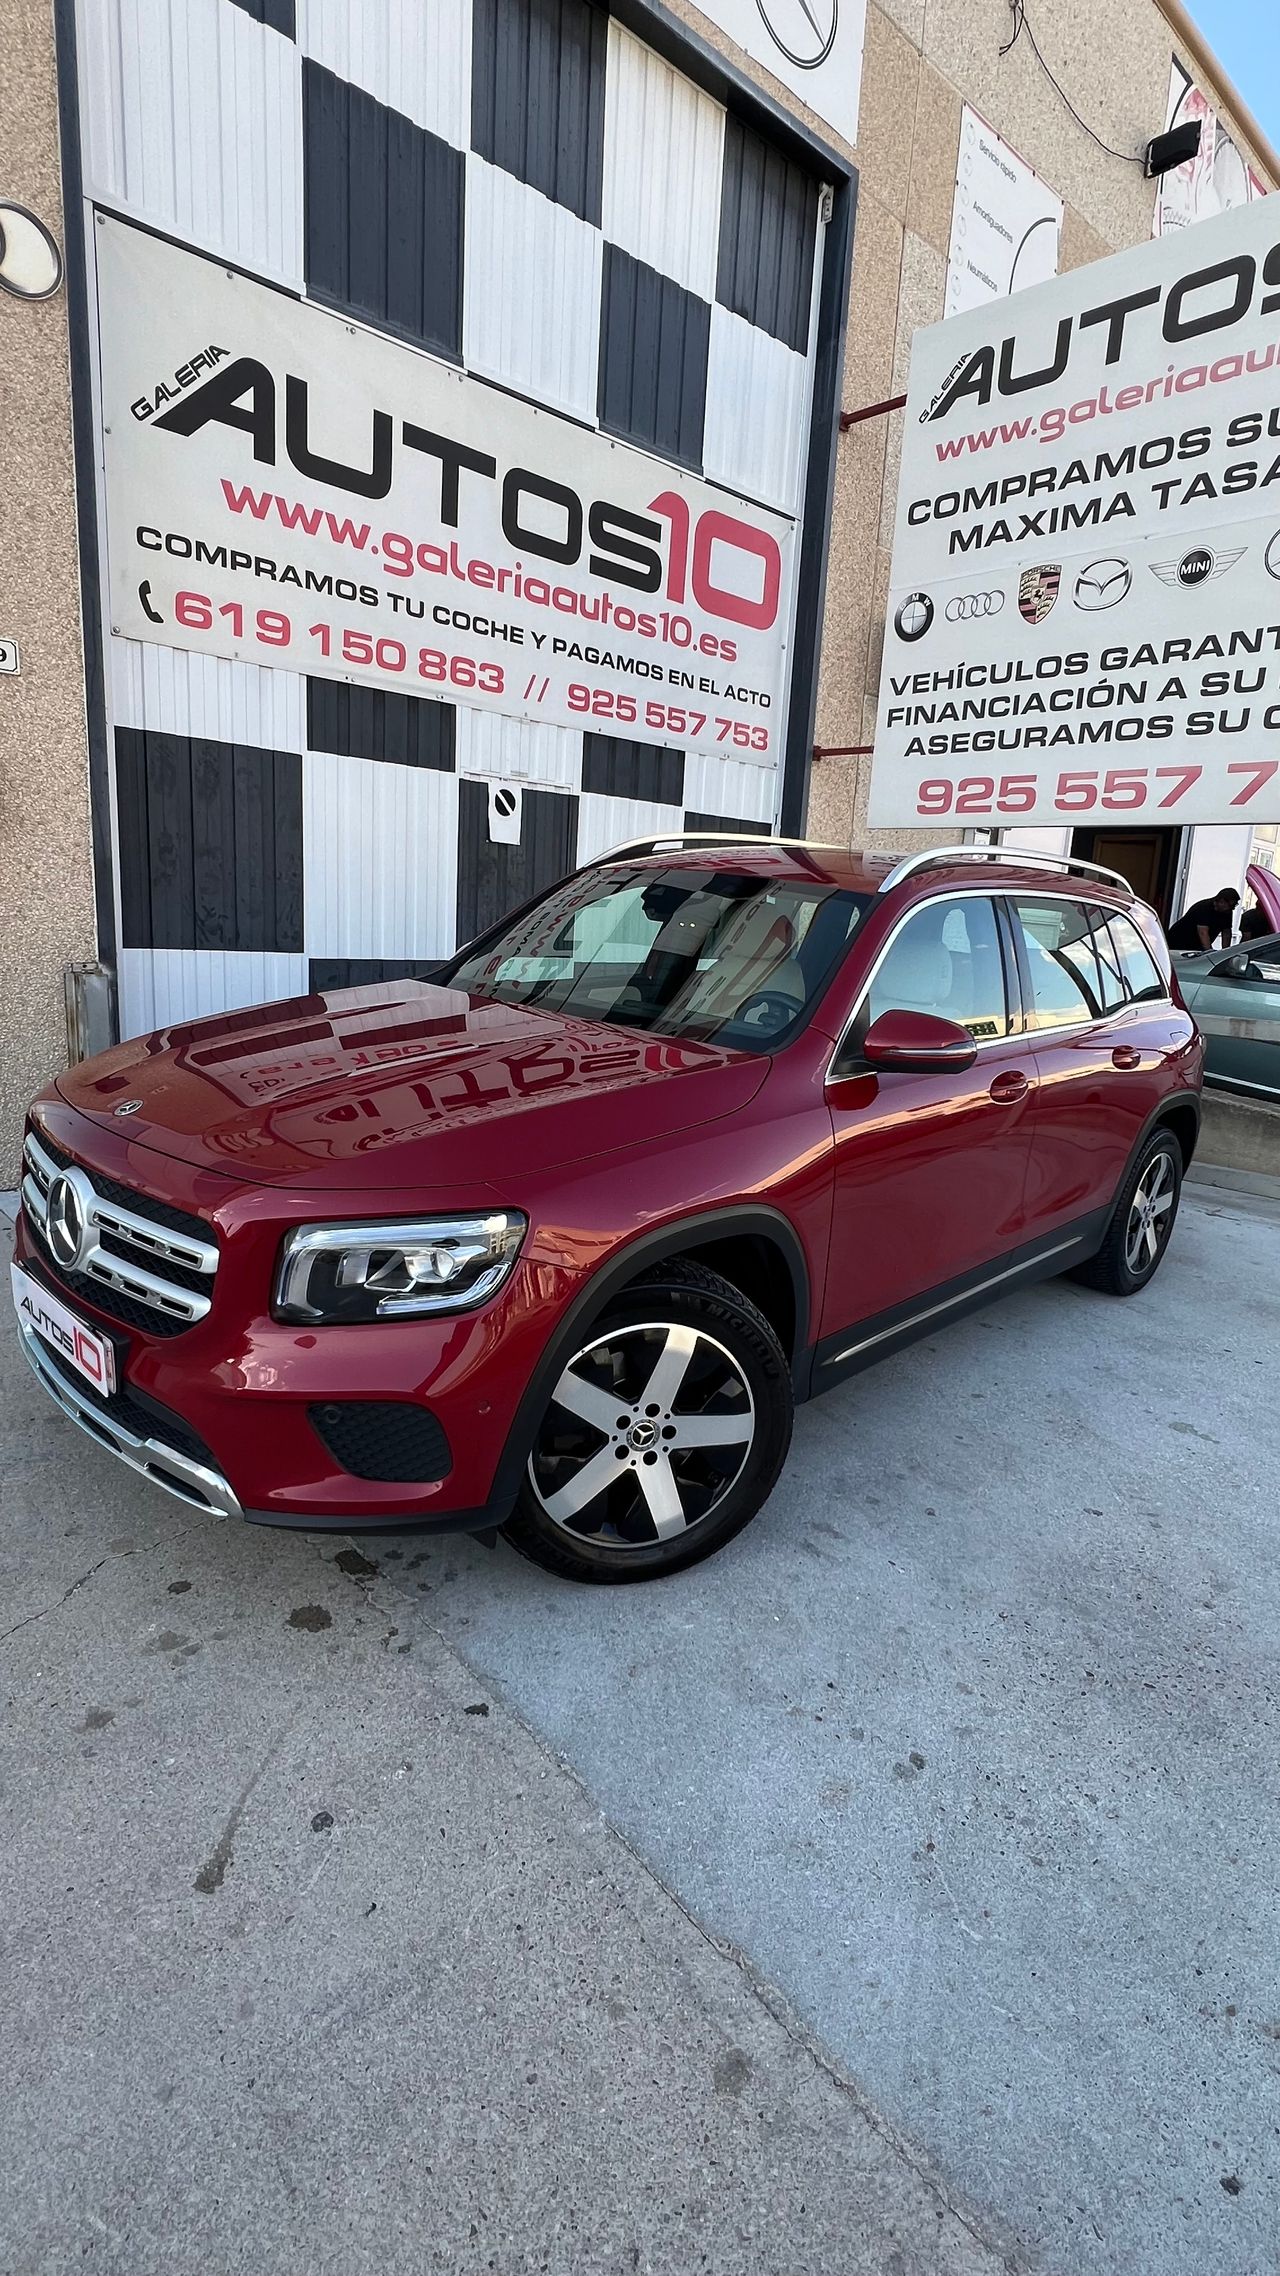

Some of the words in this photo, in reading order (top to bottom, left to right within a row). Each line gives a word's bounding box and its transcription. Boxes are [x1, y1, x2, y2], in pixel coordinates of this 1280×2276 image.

[928, 243, 1280, 421] AUTO
[131, 345, 230, 422] GALERIA
[919, 352, 972, 424] GALERIA
[150, 357, 781, 630] AUTOS10
[907, 426, 1211, 525] COMPRAMOS
[948, 492, 1136, 554] MAXIMA
[220, 479, 737, 661] www.galeriaautos10.es
[1180, 560, 1210, 575] MINI
[137, 526, 378, 606] COMPRAMOS
[387, 592, 424, 618] TU
[433, 605, 523, 644] COCHE
[531, 631, 547, 649] Y
[553, 638, 663, 680] PAGAMOS
[669, 669, 694, 689] EN
[699, 679, 719, 695] EL
[724, 684, 771, 708] ACTO
[175, 591, 290, 646] 619
[309, 623, 406, 671] 150
[419, 648, 504, 693] 863
[568, 684, 636, 722] 925
[646, 703, 706, 735] 557
[715, 718, 768, 750] 753
[887, 677, 1146, 727] FINANCIACIÓN
[1157, 677, 1187, 702] A
[1200, 667, 1266, 698] SU
[889, 652, 1088, 696] VEHÍCULOS
[904, 715, 1173, 756] ASEGURAMOS
[1186, 708, 1250, 736] SU
[916, 775, 1037, 815] 925
[1054, 765, 1202, 811] 557
[21, 1296, 102, 1382] AUTOS10
